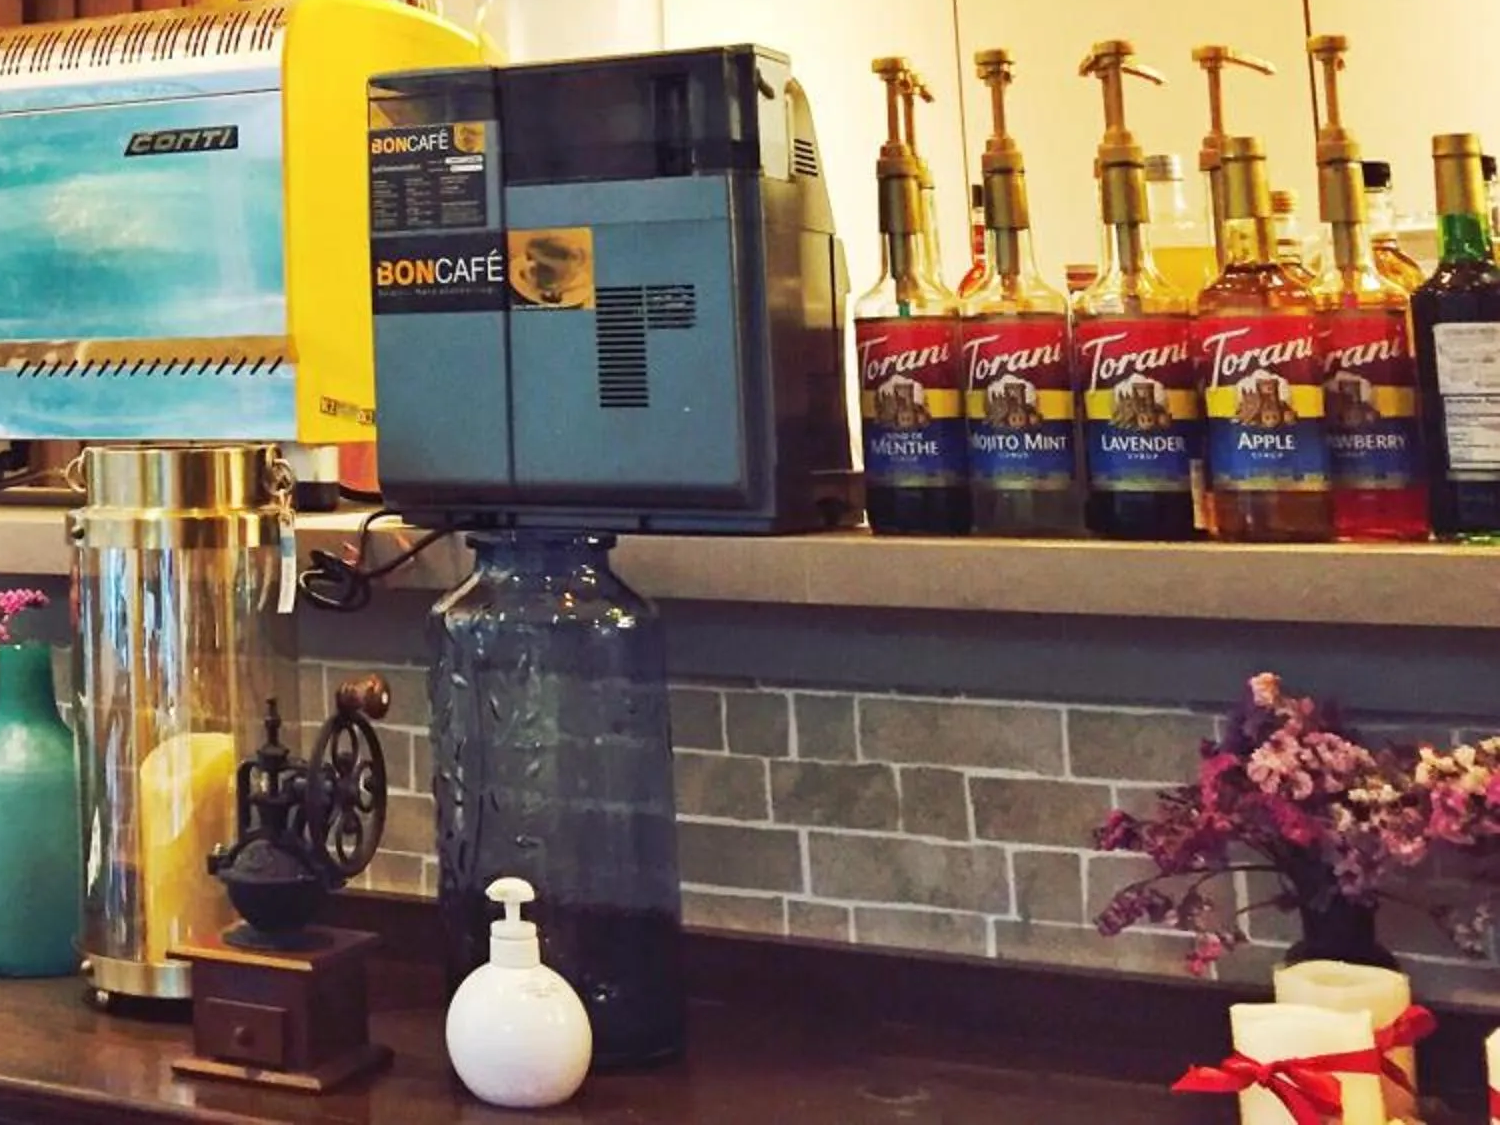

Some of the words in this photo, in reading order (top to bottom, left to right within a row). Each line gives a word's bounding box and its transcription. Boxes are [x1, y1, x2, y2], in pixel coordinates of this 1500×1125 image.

[130, 128, 232, 152] CONTI
[371, 129, 449, 154] BONCAFÉ
[376, 248, 505, 287] BONCAFÉ
[858, 332, 950, 389] Torani
[963, 331, 1063, 394] Torani
[1082, 329, 1189, 394] Torani
[1202, 323, 1314, 392] Torani
[1319, 323, 1401, 373] rani
[870, 436, 940, 456] MENTHE
[1024, 432, 1068, 452] MINT
[1100, 434, 1185, 452] LAVENDER
[1237, 432, 1296, 450] APPLE
